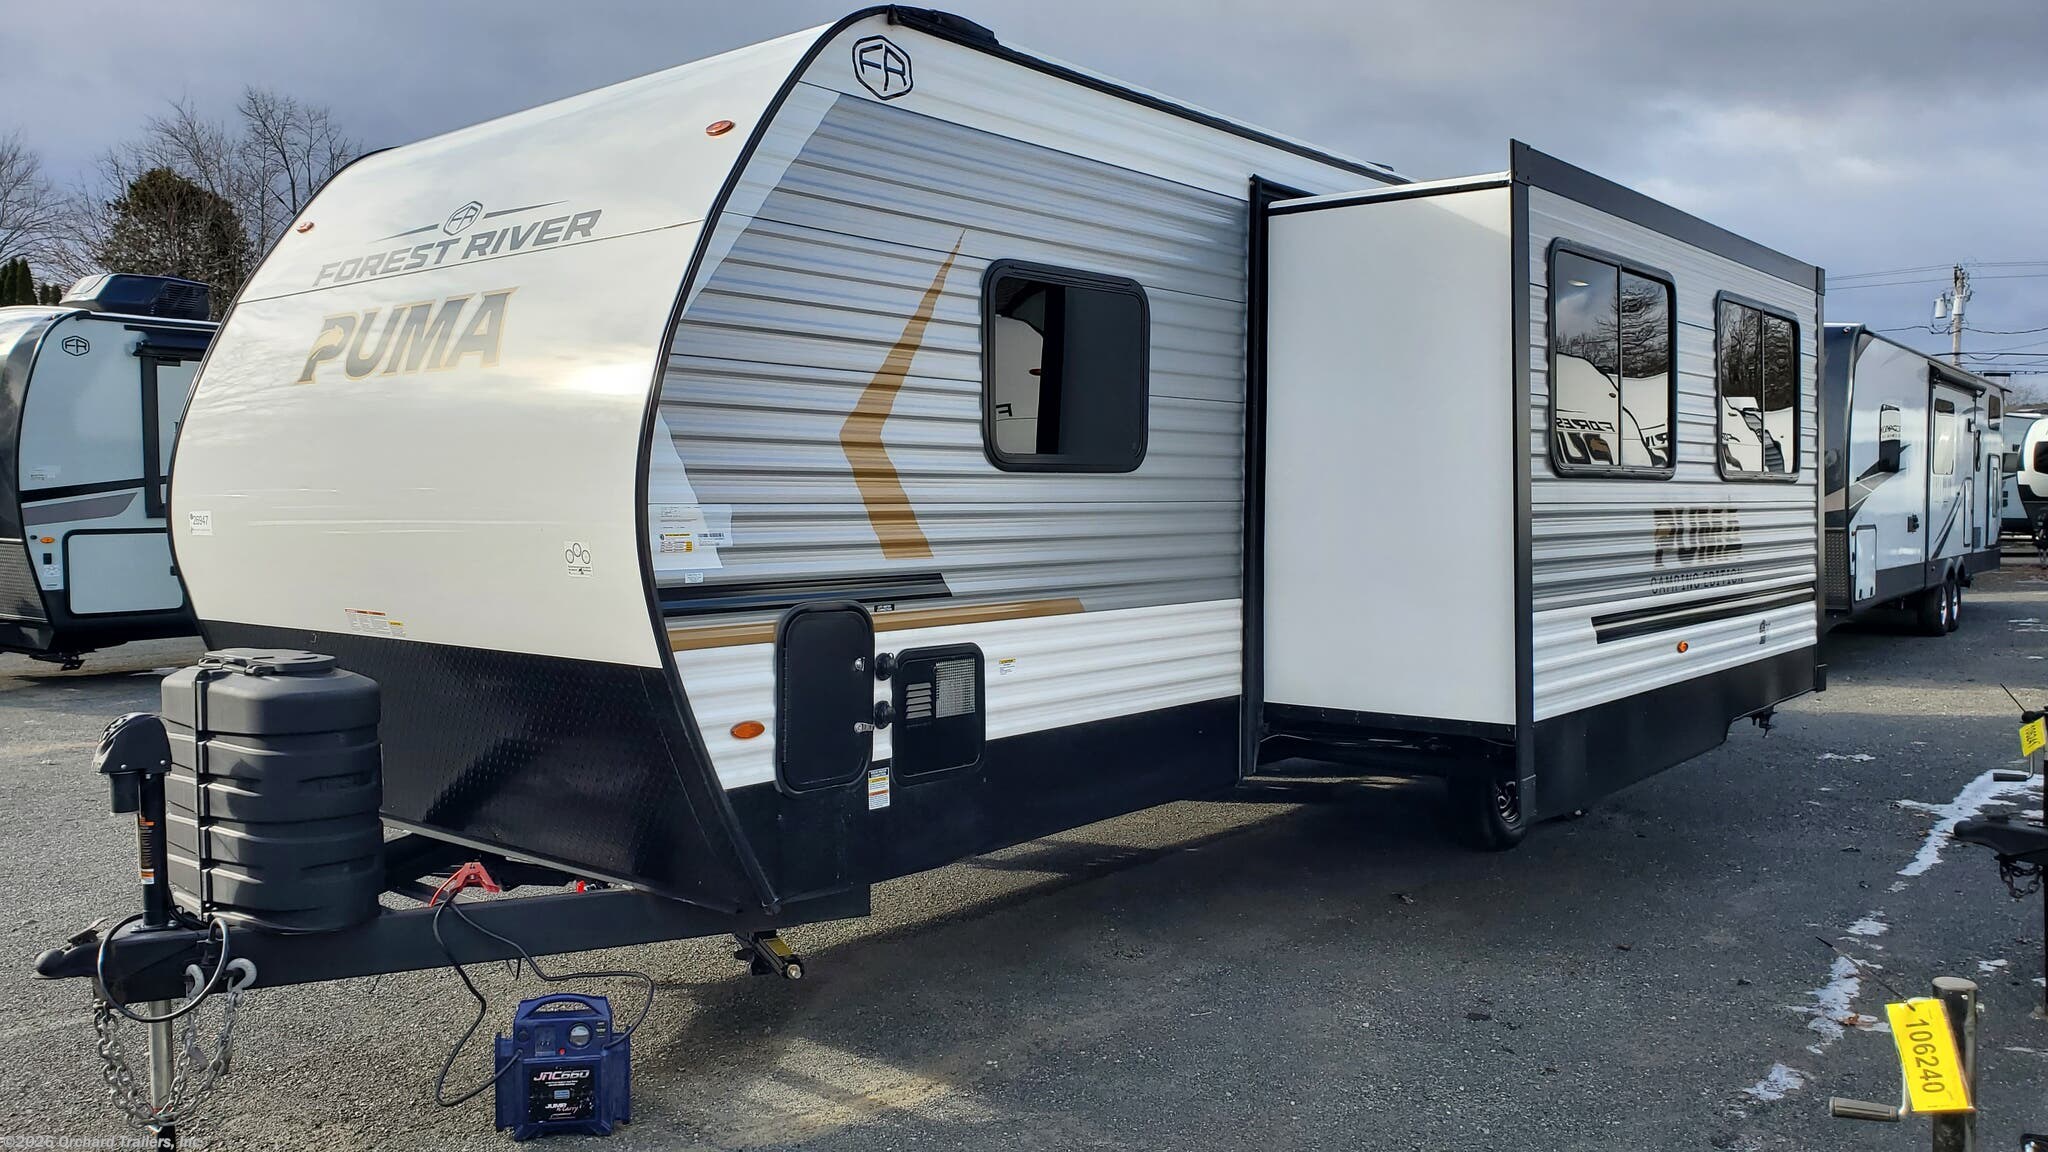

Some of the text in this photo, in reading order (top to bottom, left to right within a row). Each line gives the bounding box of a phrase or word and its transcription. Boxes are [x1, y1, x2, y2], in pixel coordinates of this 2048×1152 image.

[312, 208, 603, 287] FOREST RIVER
[295, 286, 520, 385] PUMA
[1653, 507, 1744, 569] PUMA
[1703, 567, 1745, 589] EDITION
[533, 1070, 589, 1081] JNC660
[1905, 1018, 1945, 1093] 106240
